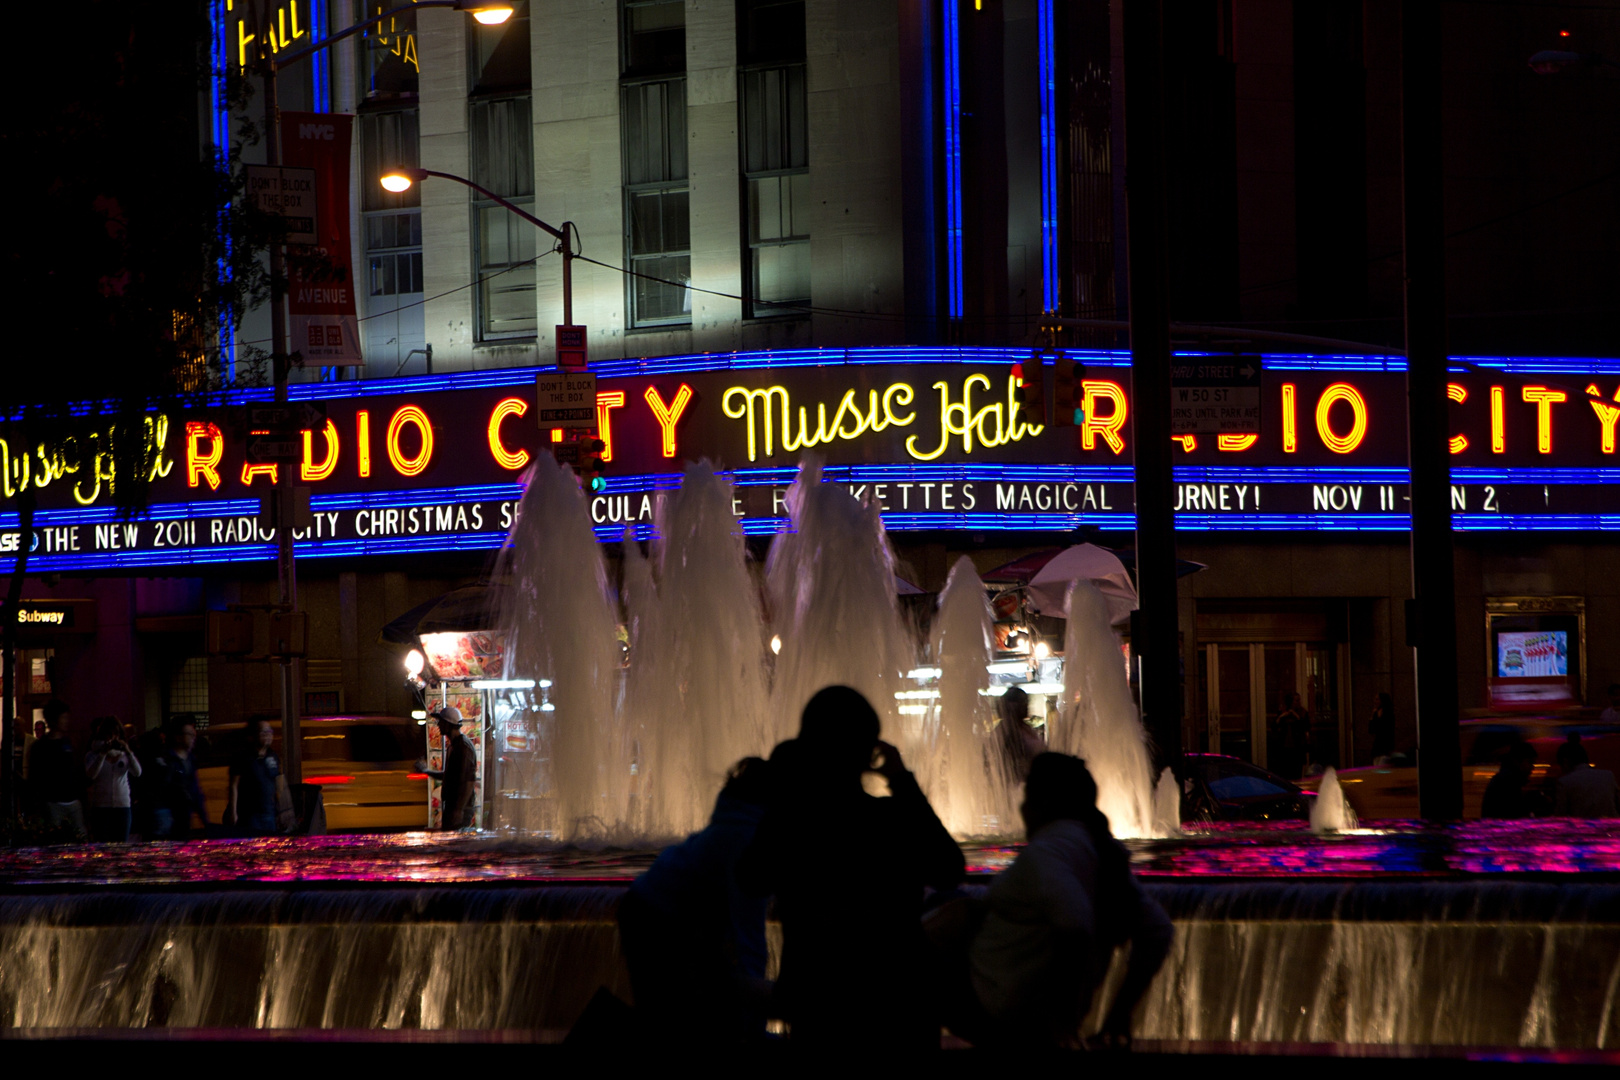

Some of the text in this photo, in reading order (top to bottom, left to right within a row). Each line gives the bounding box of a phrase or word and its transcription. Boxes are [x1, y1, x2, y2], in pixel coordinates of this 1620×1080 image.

[299, 123, 335, 141] NYC
[282, 179, 312, 193] BLOCK
[284, 194, 302, 207] BOX
[297, 288, 347, 304] AVENUE
[1198, 365, 1236, 379] STREET
[541, 380, 592, 392] DON'T BLOCK
[550, 392, 584, 403] THE BOX
[1179, 389, 1229, 402] W 50 ST
[1196, 408, 1218, 419] UNTIL
[1221, 408, 1242, 418] PARK
[1245, 407, 1259, 418] AVE
[487, 382, 694, 470] CTY
[1081, 380, 1368, 454] RIO
[43, 526, 81, 552] THE
[95, 523, 139, 549] NEW
[153, 520, 196, 547] 2011
[355, 503, 484, 537] CHRISTMAS
[995, 484, 1113, 511] MAGICAL
[1313, 485, 1363, 511] NOV
[18, 609, 65, 625] Subway
